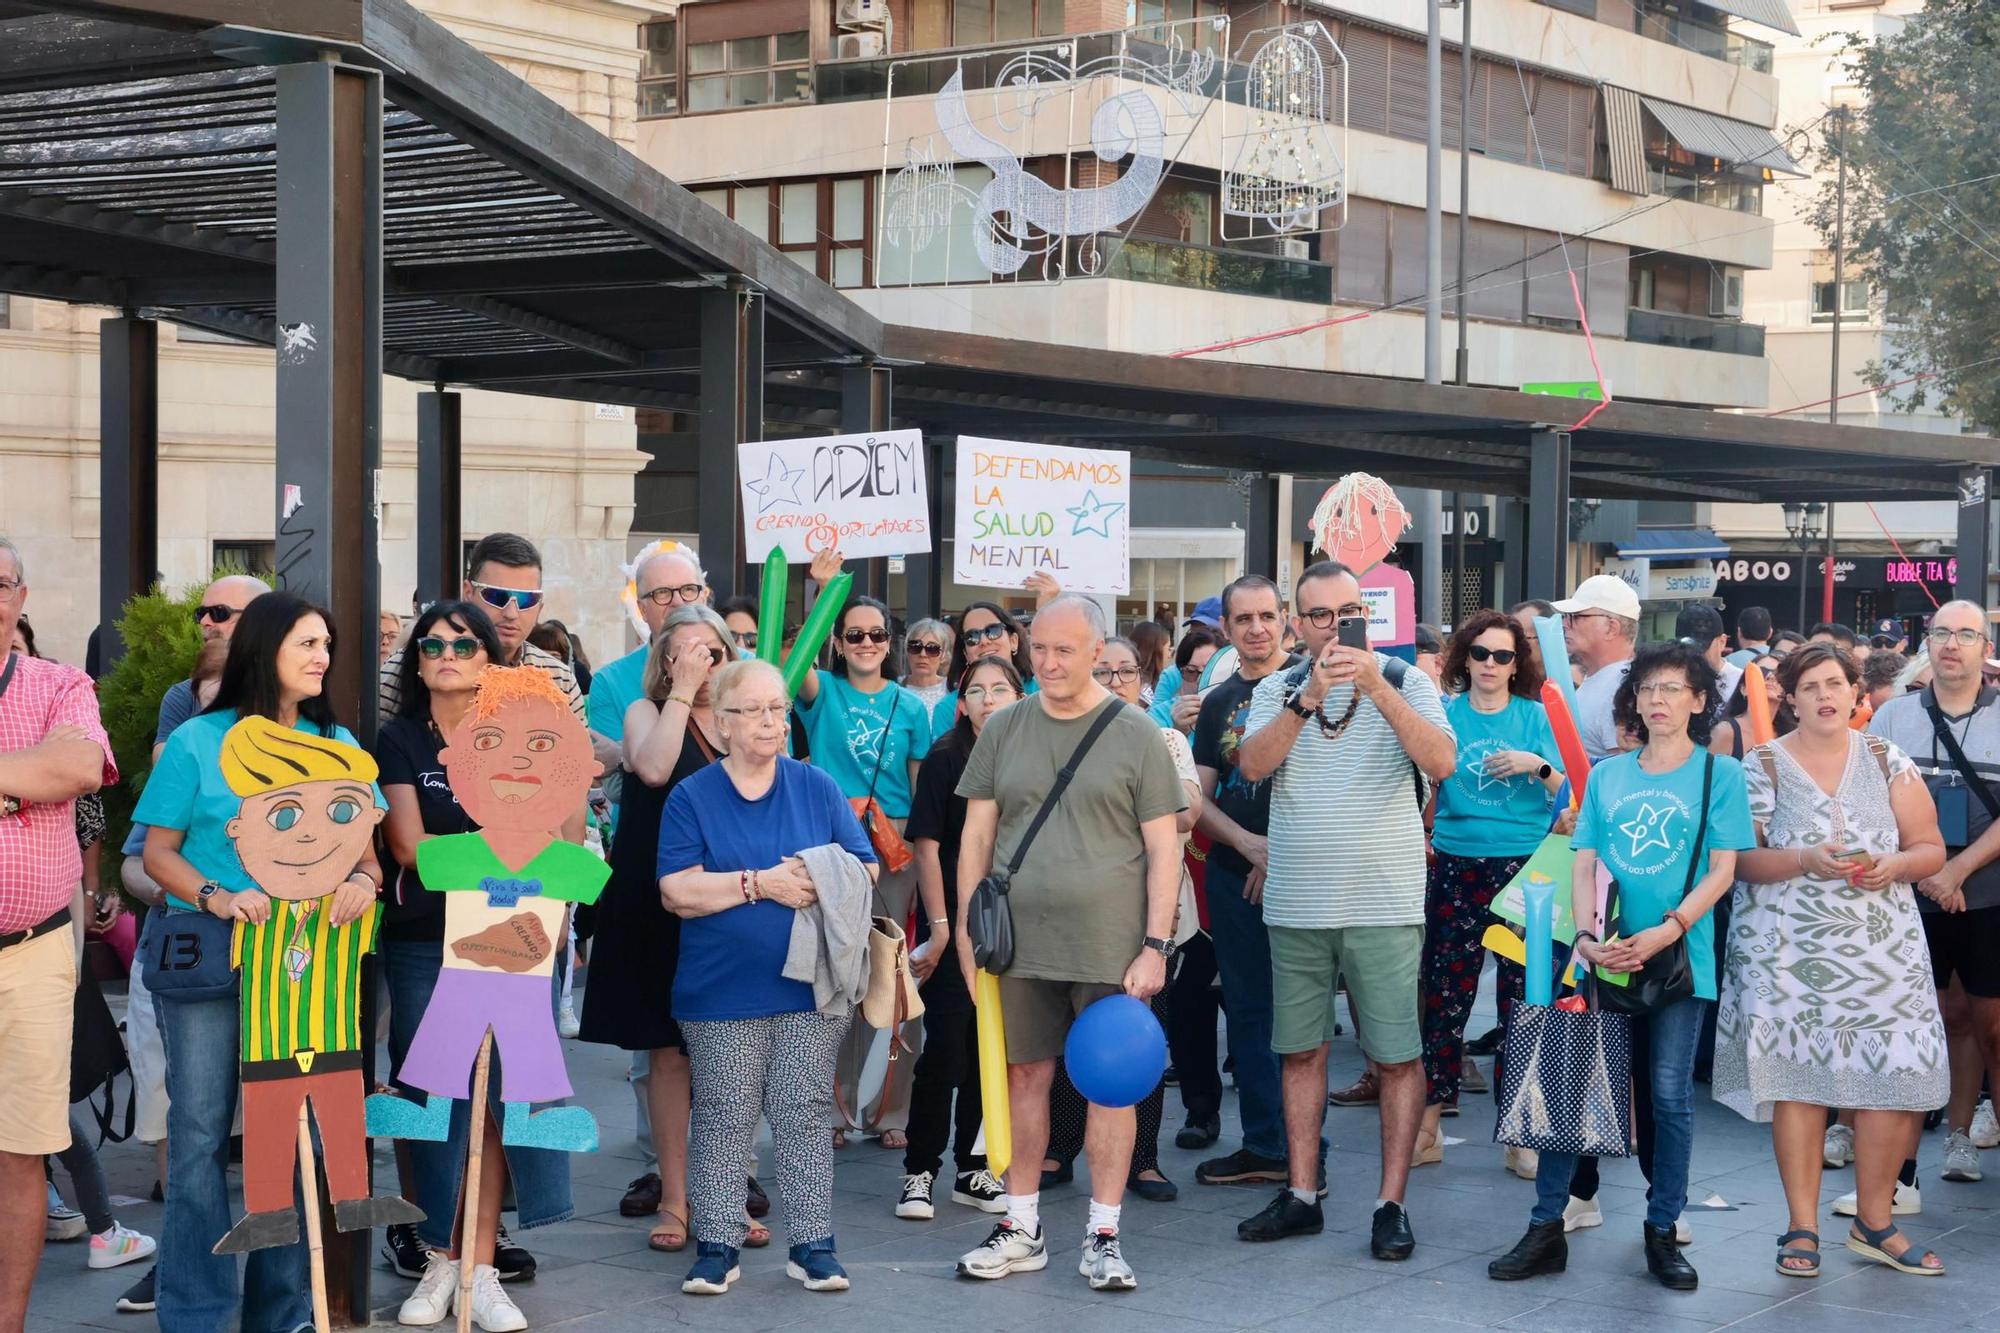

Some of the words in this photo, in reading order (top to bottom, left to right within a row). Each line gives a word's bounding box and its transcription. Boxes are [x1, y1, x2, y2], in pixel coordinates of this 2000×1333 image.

[972, 452, 1121, 485] DEFENDAMOS
[974, 485, 1004, 506] LA
[756, 513, 827, 531] CREANDO
[973, 509, 1054, 539] SALUD
[969, 543, 1069, 570] MENTAL
[1886, 562, 1922, 582] BUBBLE
[1926, 562, 1943, 581] TEA
[1623, 788, 1655, 801] mental
[1664, 850, 1680, 866] una
[1628, 866, 1645, 875] con
[1645, 863, 1665, 876] vida
[511, 921, 543, 960] CREANDO
